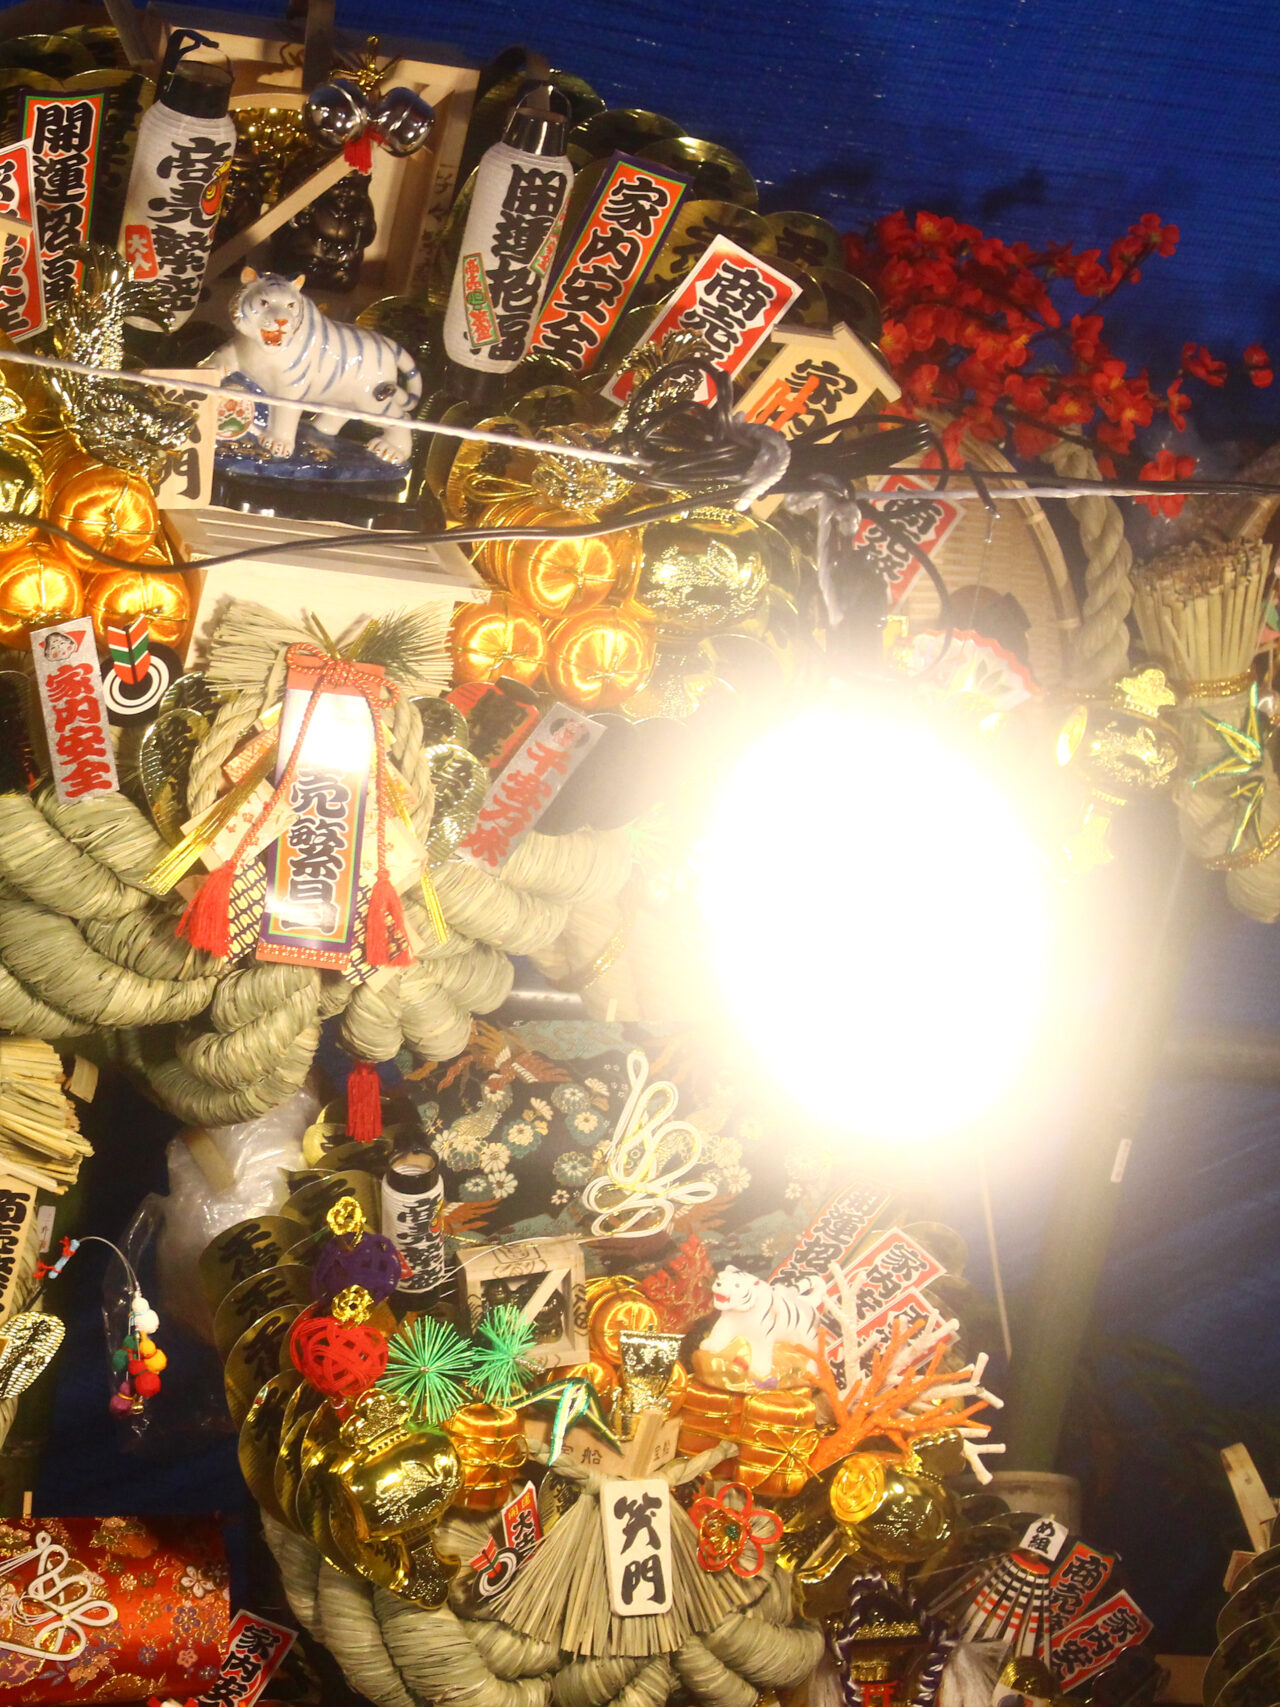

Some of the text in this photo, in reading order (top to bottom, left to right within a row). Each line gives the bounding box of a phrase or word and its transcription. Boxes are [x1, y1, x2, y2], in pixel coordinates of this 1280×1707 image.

[32, 101, 96, 307] 開運招福
[127, 234, 154, 272] 大入
[466, 163, 568, 362] 開運招福
[531, 176, 670, 371] 家内安全
[660, 259, 777, 400] 商売
[46, 664, 113, 798] 家内安全
[279, 769, 351, 935] 売繁昌
[459, 741, 572, 868] 千客万来
[820, 1243, 929, 1335] 家内安
[614, 1493, 664, 1604] 笑門
[1028, 1521, 1056, 1554] め組
[1050, 1555, 1109, 1632] 商売
[198, 1624, 281, 1707] 家内安
[1050, 1607, 1144, 1679] 家内安
